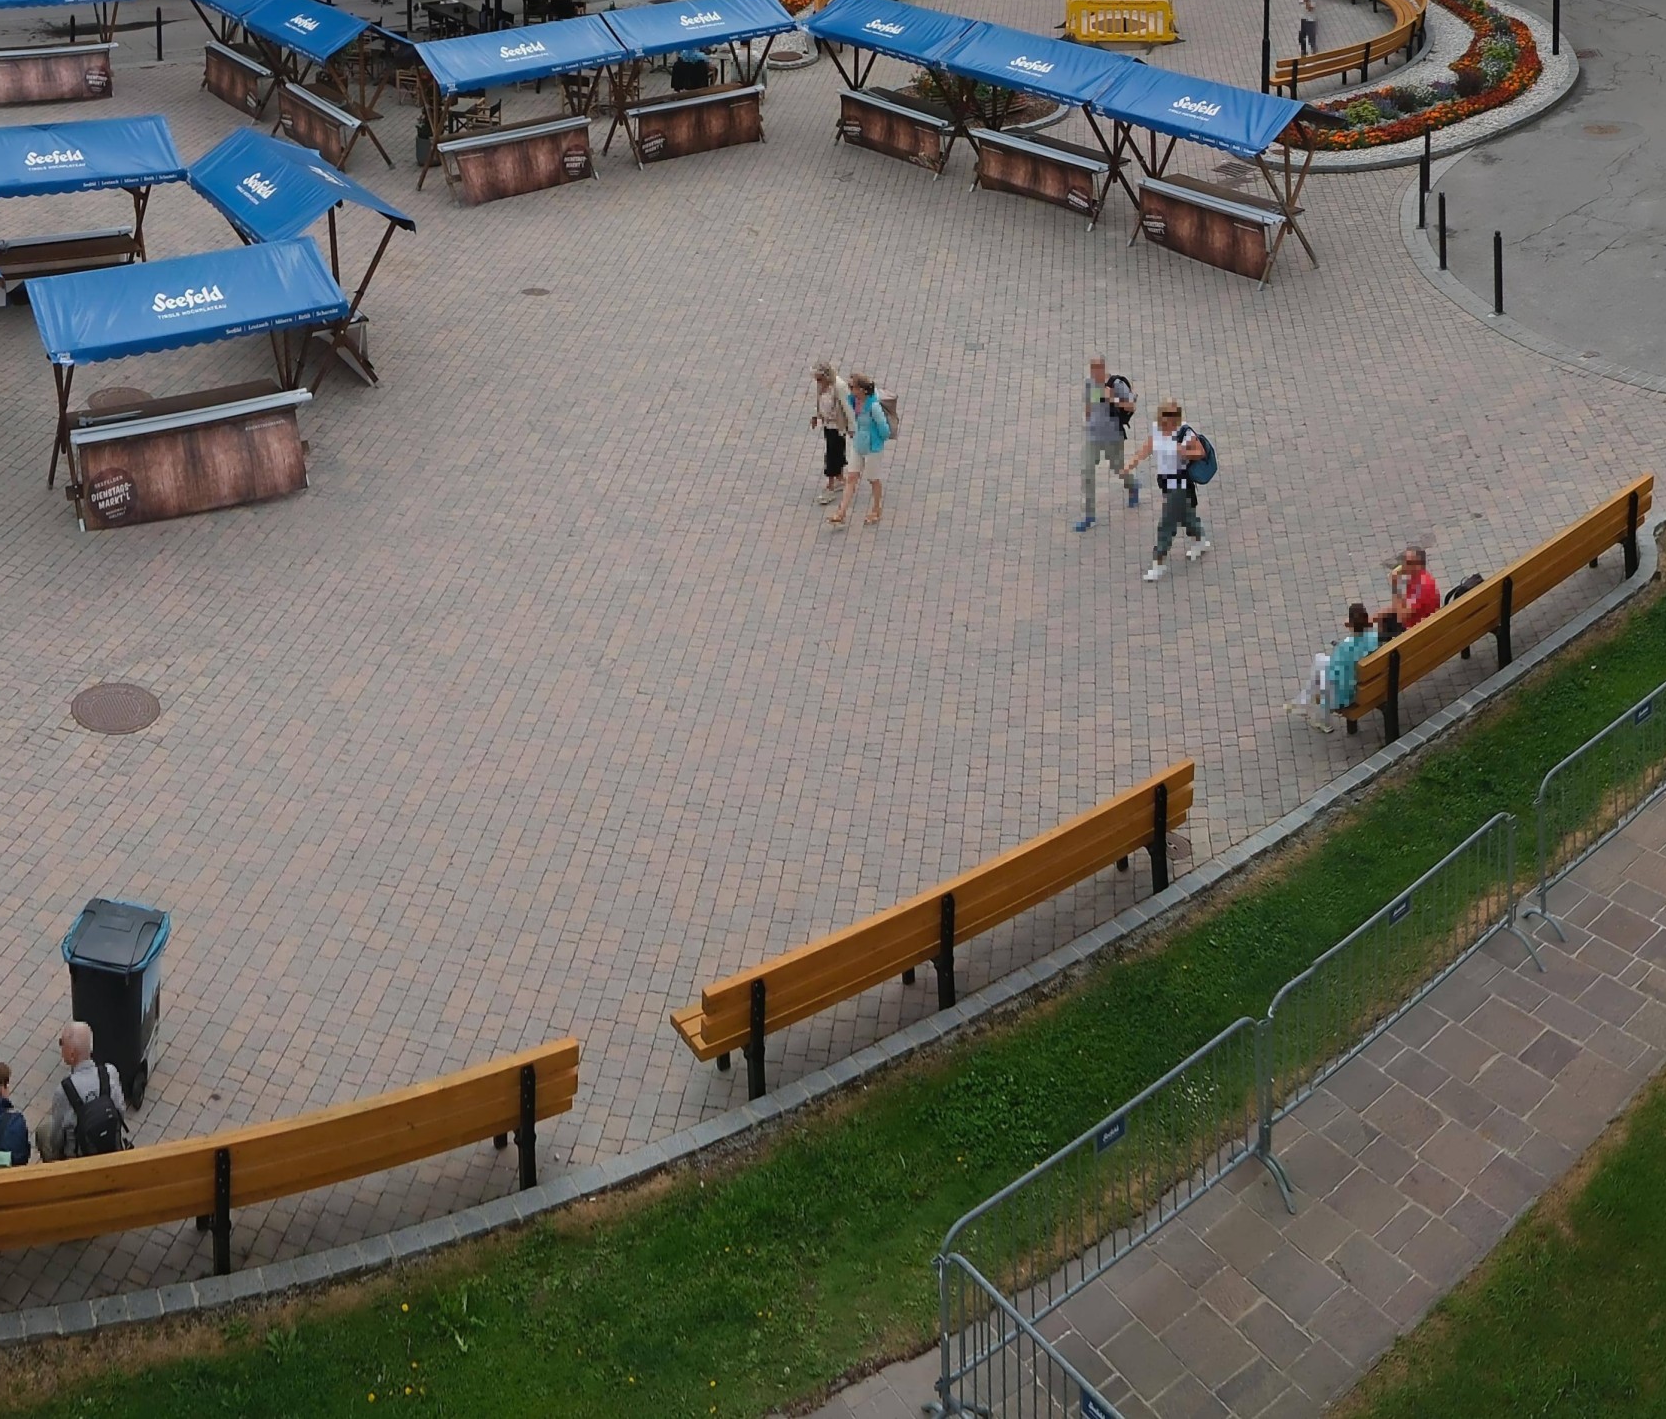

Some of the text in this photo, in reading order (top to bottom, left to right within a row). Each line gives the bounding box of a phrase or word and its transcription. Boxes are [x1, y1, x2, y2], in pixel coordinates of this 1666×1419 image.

[680, 11, 722, 27] Seefeld
[865, 18, 905, 36] Seefeld
[499, 40, 546, 59] Seefeld
[1009, 55, 1055, 75] Seefeld
[1172, 95, 1222, 117] Seefeld
[24, 148, 84, 166] Seefeld
[242, 172, 278, 200] Seefeld
[152, 284, 225, 313] Seefeld
[157, 304, 227, 321] TIROLS HOCHPLATEAU
[91, 482, 132, 503] DIENSTAGS-
